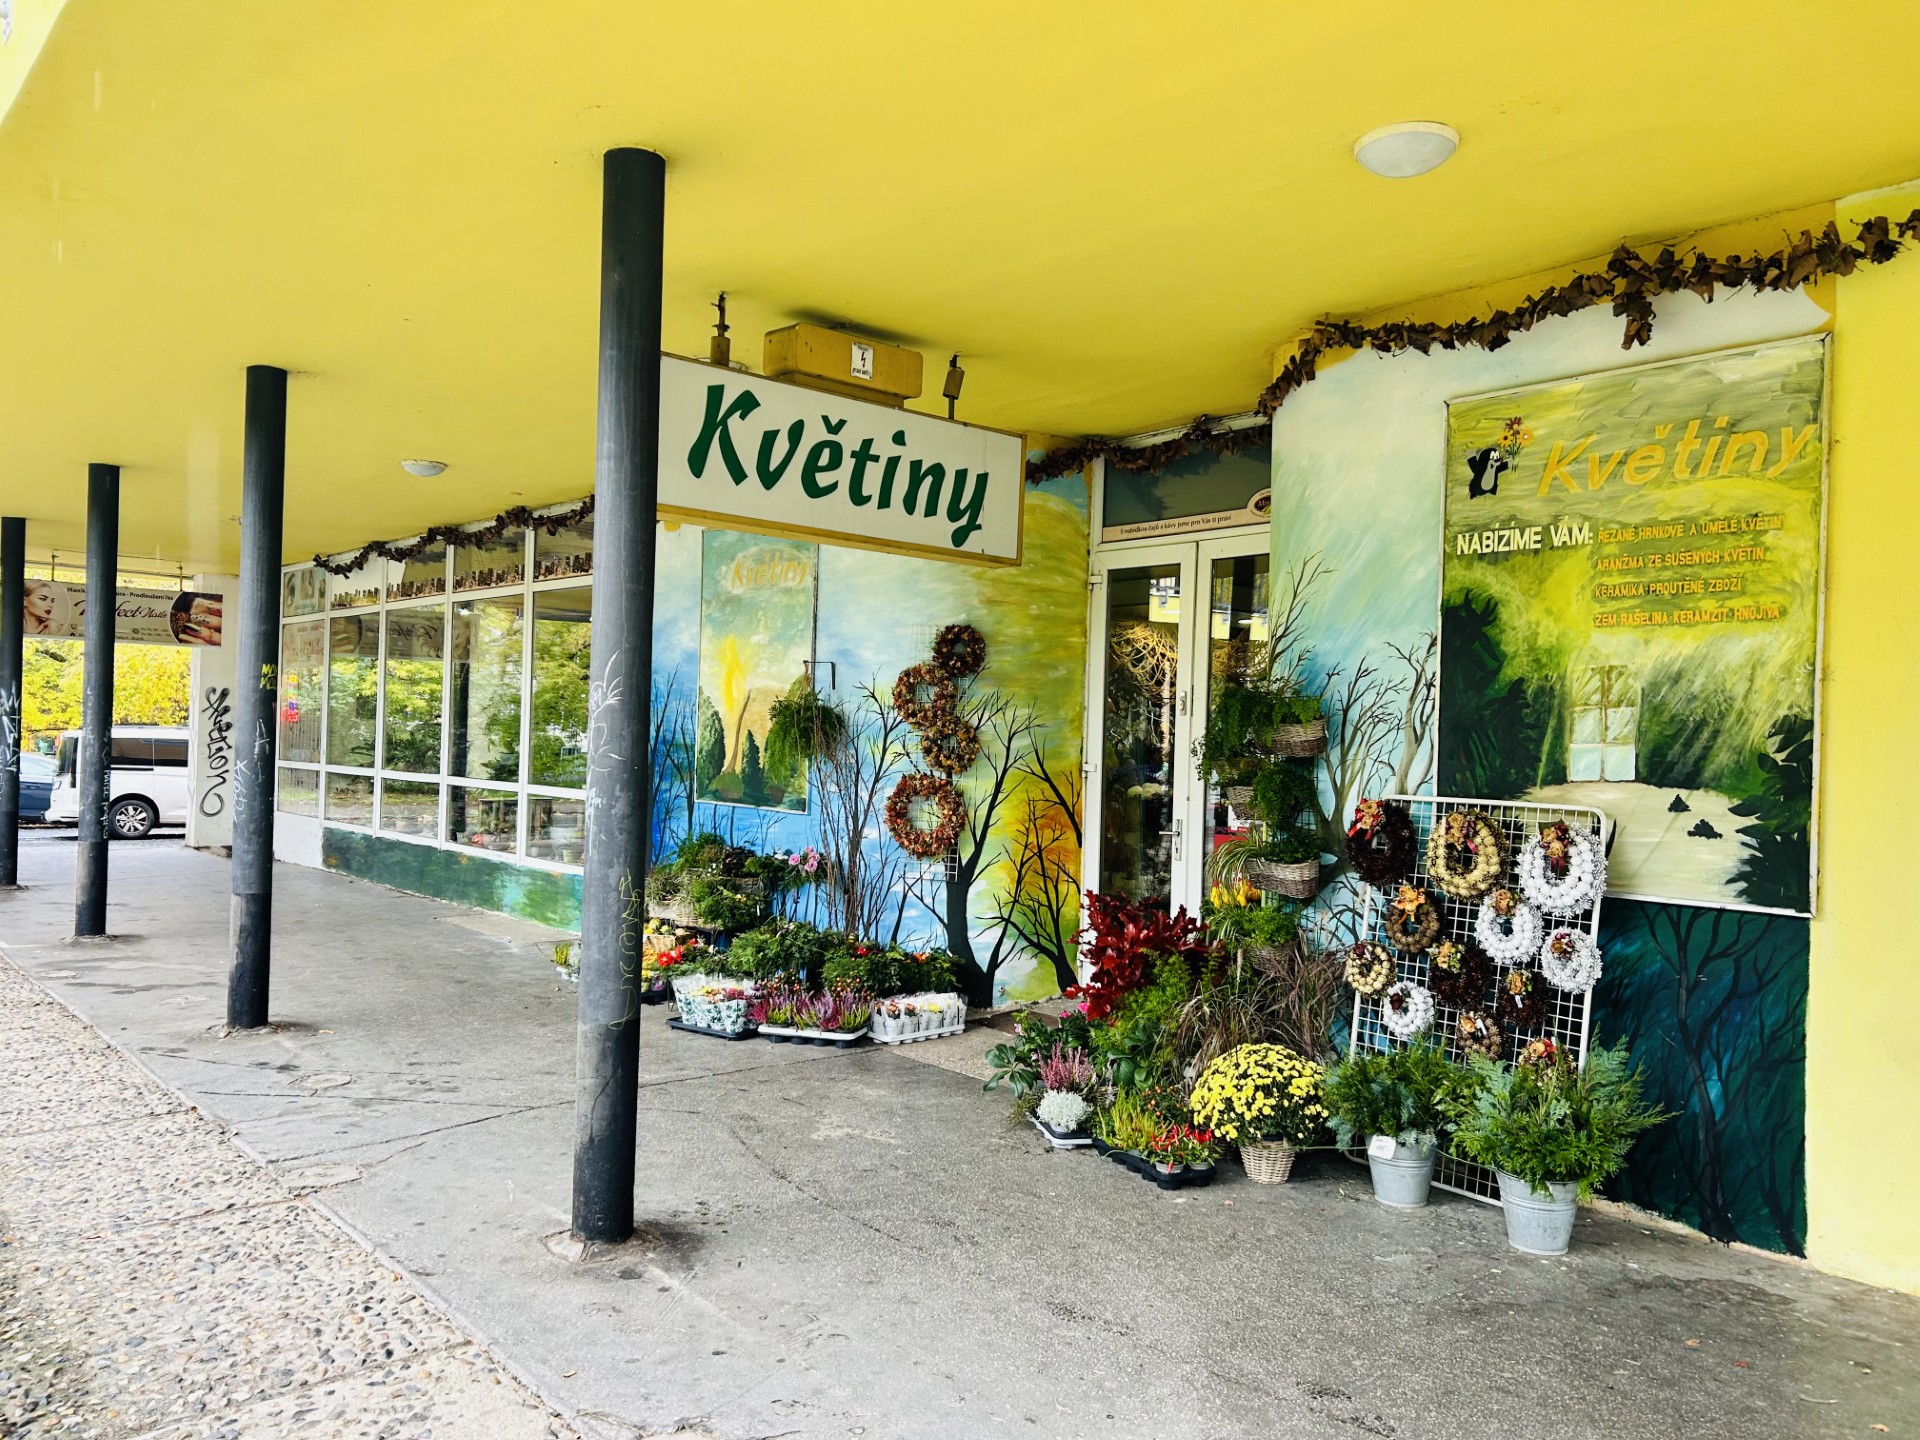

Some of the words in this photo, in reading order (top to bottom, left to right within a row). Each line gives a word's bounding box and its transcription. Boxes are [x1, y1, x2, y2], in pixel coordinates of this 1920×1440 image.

[687, 384, 989, 548] Květiny
[1537, 416, 1820, 497] Květiny
[1124, 525, 1148, 534] nabídkou
[1148, 523, 1159, 532] čajů
[1164, 521, 1176, 530] kávy
[1177, 520, 1190, 528] jsme
[1191, 519, 1201, 528] pro
[1457, 520, 1542, 555] NABÍZÍME
[1550, 515, 1593, 547] VÁM:
[1639, 520, 1685, 541] HRNKOVÉ
[1690, 523, 1698, 536] A
[1702, 515, 1738, 535] UMĚLÉ
[1596, 552, 1645, 571] ARANŽMÁ
[1648, 555, 1662, 568] ZE
[1665, 547, 1720, 566] SUŠENÝCH
[1724, 545, 1765, 562] KVĚTIN
[1596, 583, 1645, 599] KERAMIKA
[1649, 576, 1705, 595] PROUTĚNÉ
[1708, 572, 1743, 592] ZBOŽÍ
[1621, 608, 1668, 626] RAŠELINA
[1734, 605, 1779, 621] HNOJIVA
